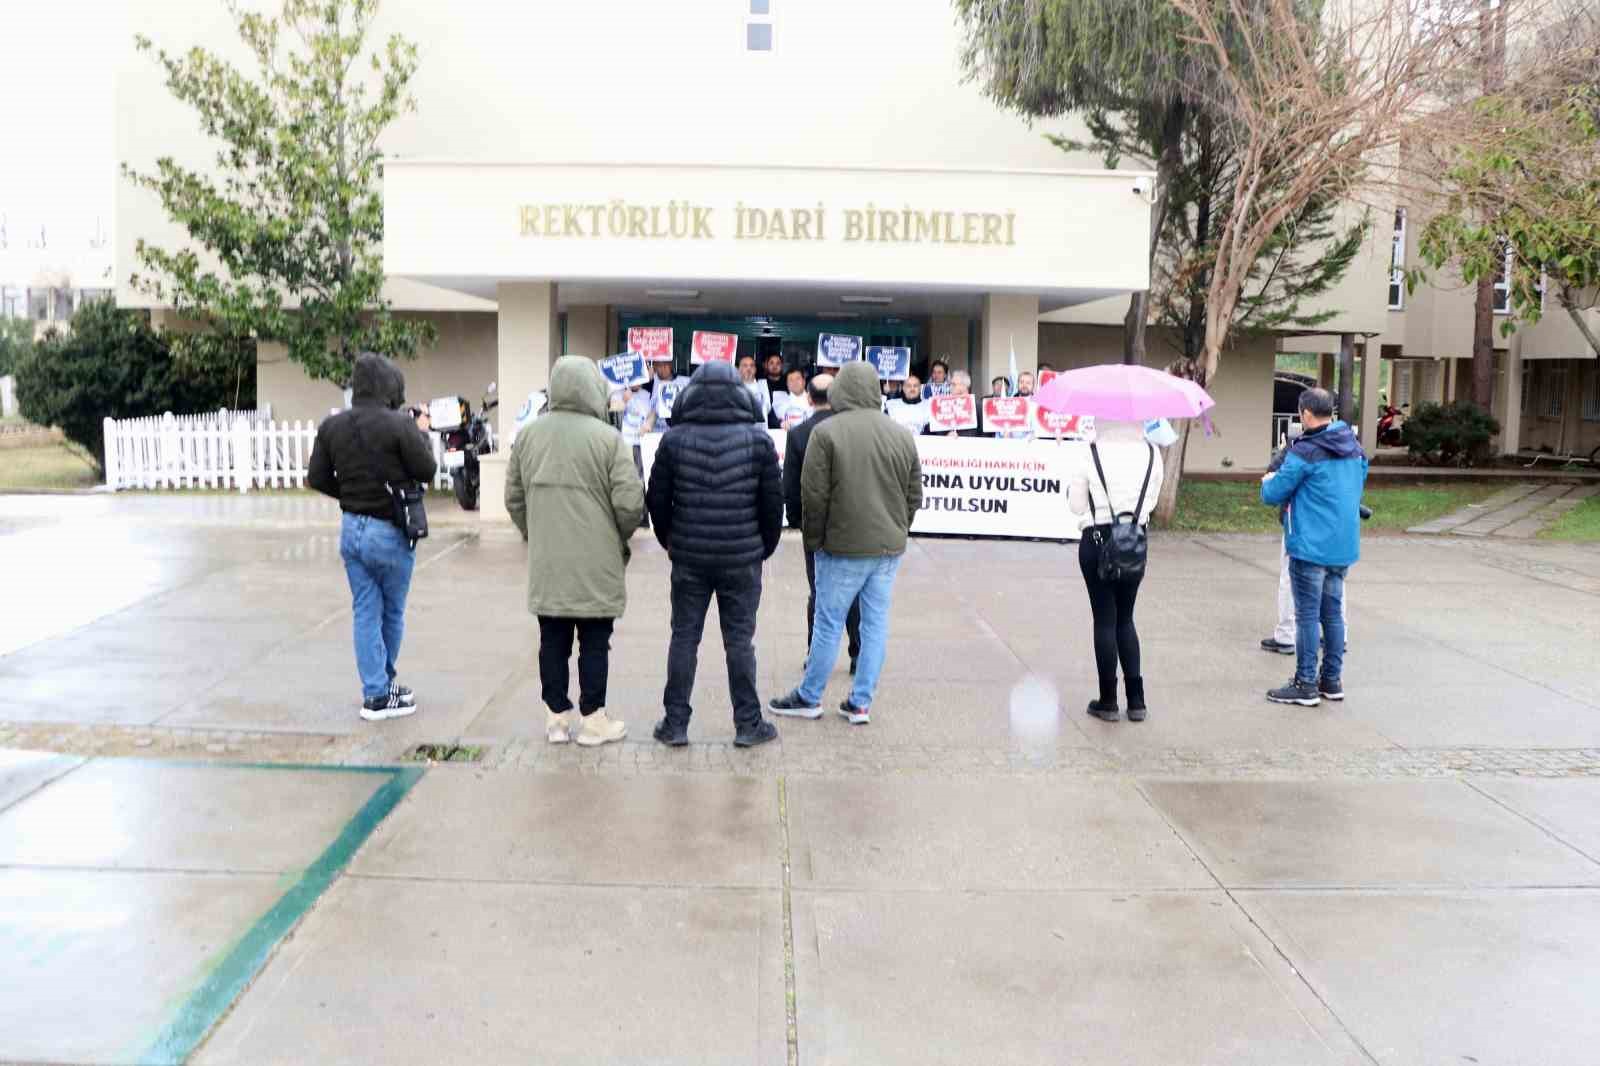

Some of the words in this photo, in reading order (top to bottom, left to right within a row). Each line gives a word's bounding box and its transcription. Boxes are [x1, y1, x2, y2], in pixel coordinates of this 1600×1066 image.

[519, 200, 715, 239] REKTÖRLÜK
[735, 201, 827, 240] İDARİ
[985, 460, 1020, 470] HAKKI
[969, 475, 1060, 494] UYULSUN
